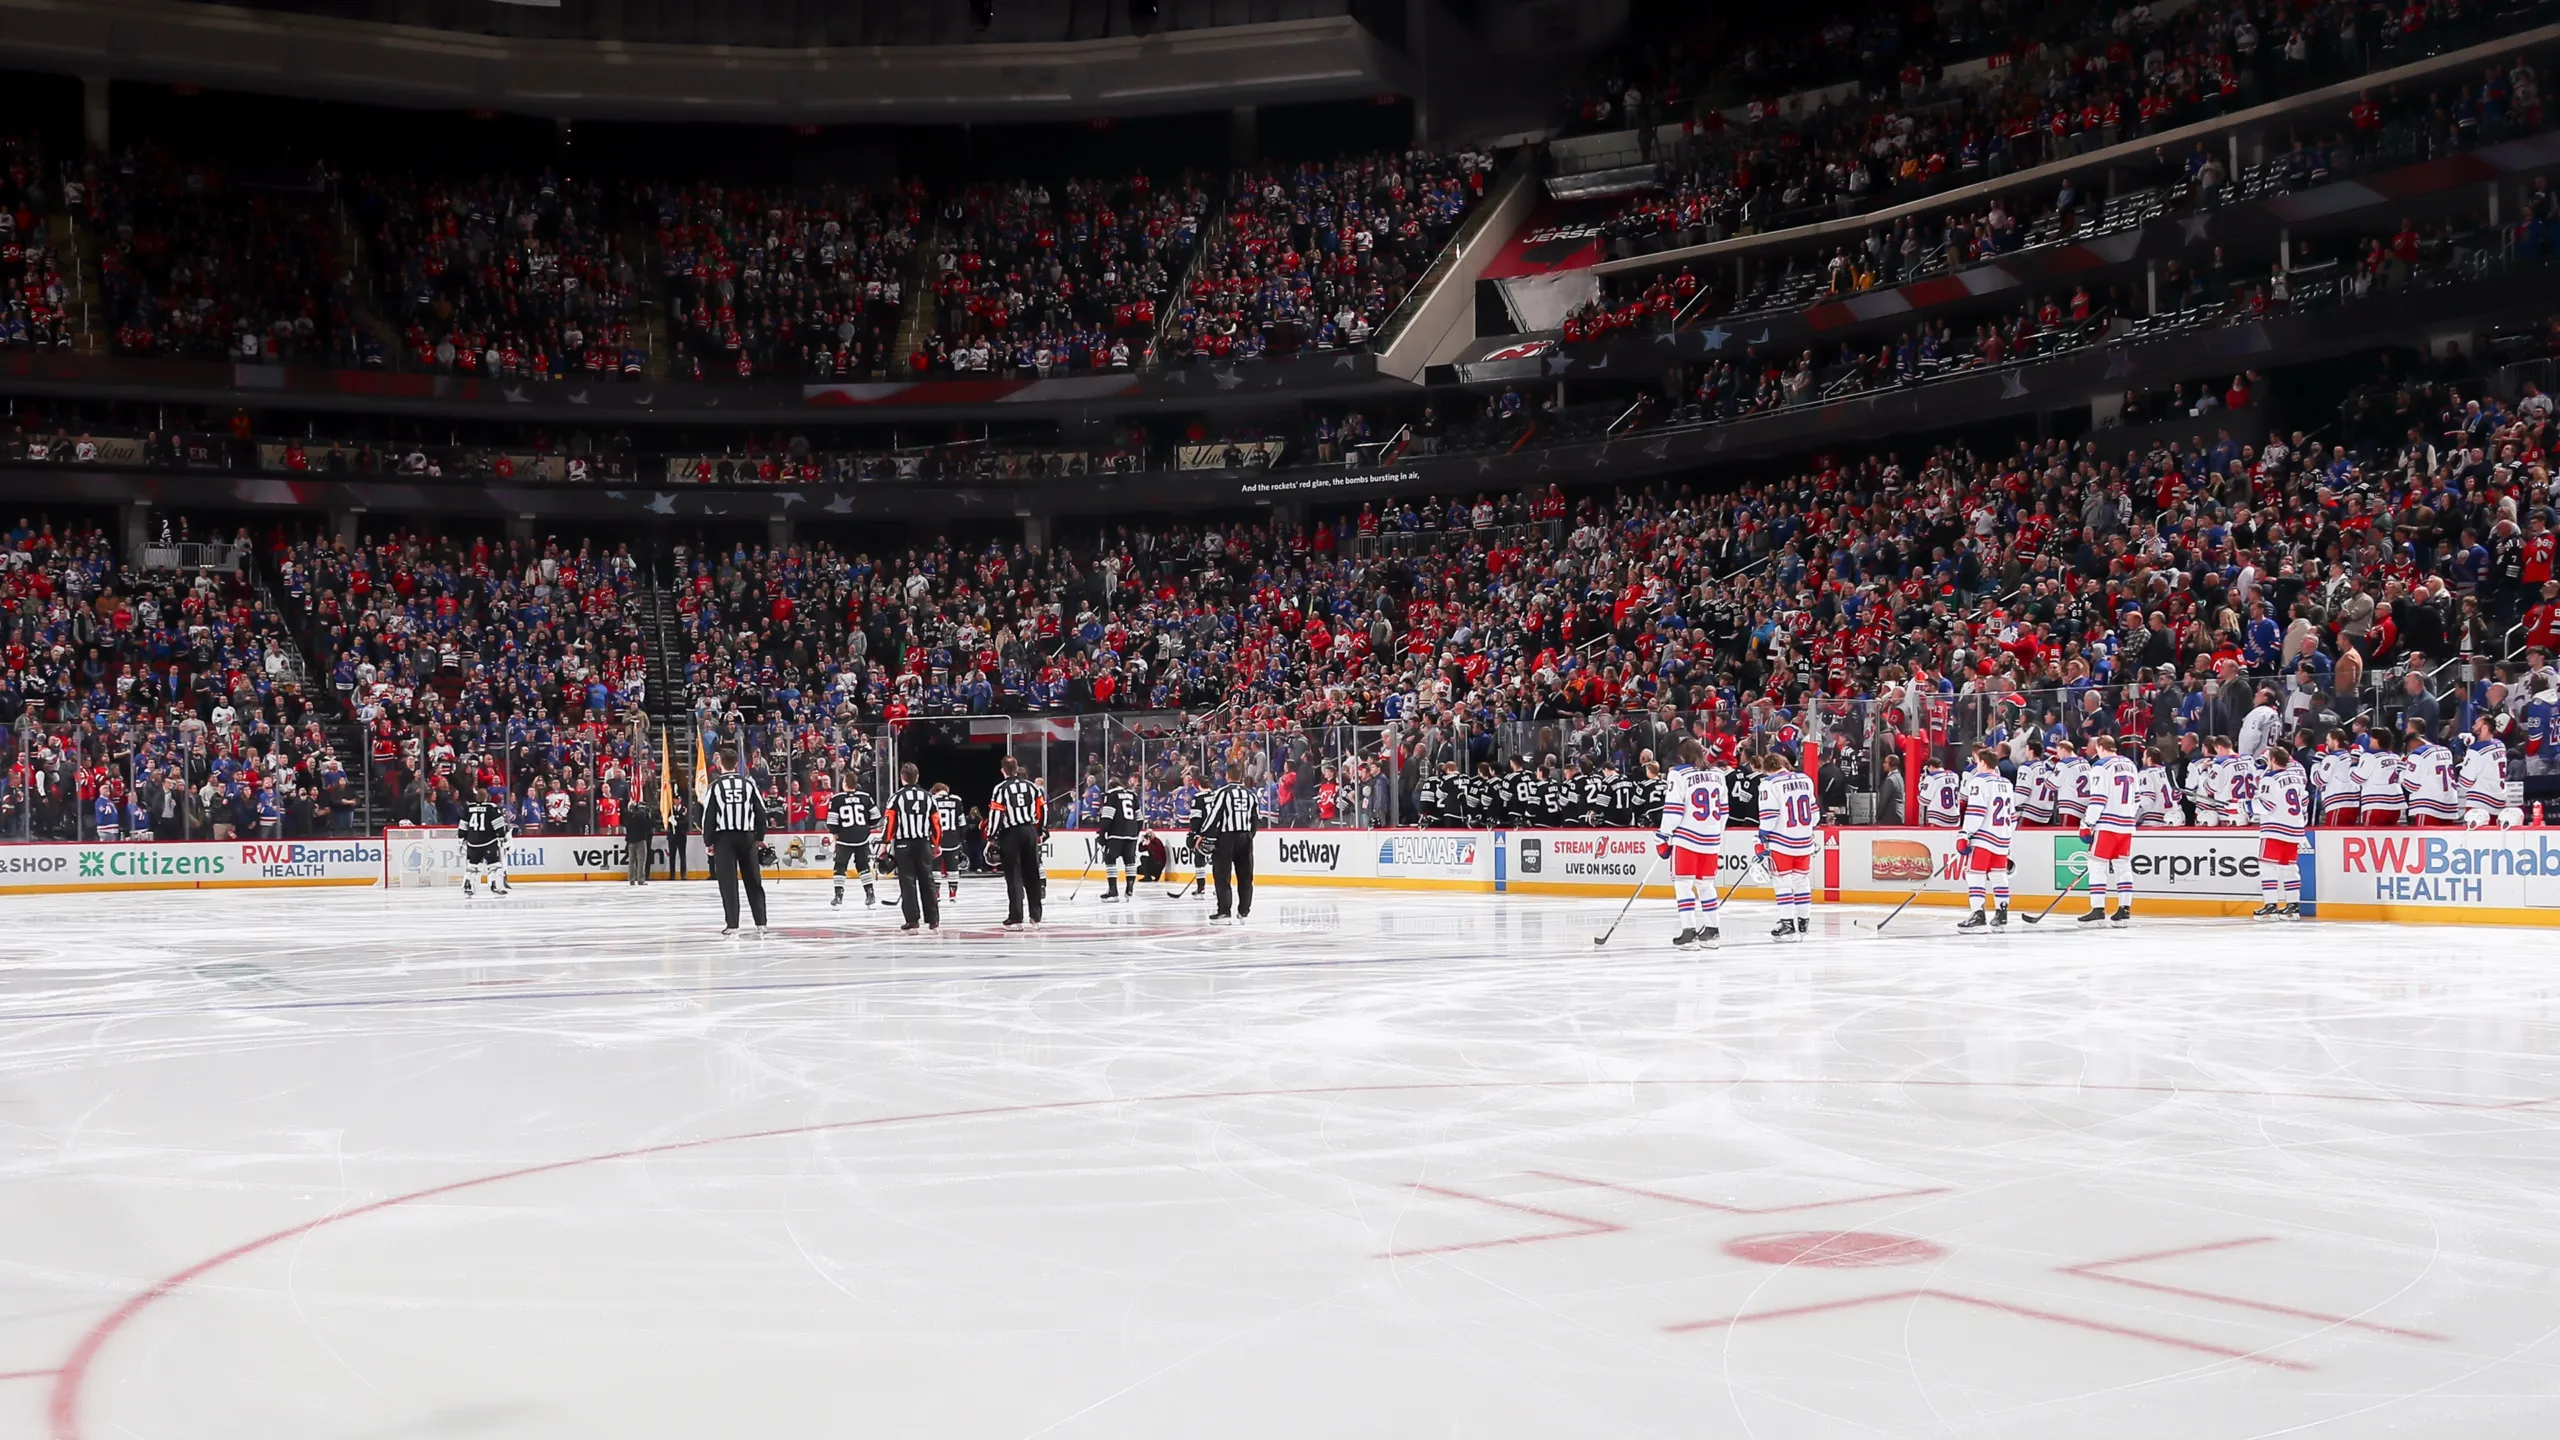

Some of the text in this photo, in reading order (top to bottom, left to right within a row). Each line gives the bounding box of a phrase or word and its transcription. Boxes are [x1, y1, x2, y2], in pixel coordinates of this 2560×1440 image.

[1531, 223, 1588, 234] MADE
[1241, 471, 1420, 493] And the rockets' red glare, the bombs bursting in air,
[725, 789, 742, 804] 55
[2231, 773, 2256, 800] 26
[911, 802, 920, 814] 4
[1017, 793, 1025, 806] 6
[1233, 798, 1249, 811] 52
[1615, 789, 1630, 809] 17
[1691, 787, 1722, 822] 93
[838, 803, 866, 828] 96
[1123, 800, 1134, 820] 6
[1785, 794, 1812, 828] 10
[1992, 797, 2012, 827] 23
[468, 813, 485, 831] 41
[441, 847, 545, 868] Prntial
[573, 844, 665, 867] verizn
[1279, 838, 1341, 870] betway
[1394, 837, 1459, 865] HALMAR
[1554, 841, 1646, 854] STREAM GAMES
[110, 851, 225, 876] Citizens
[262, 864, 324, 877] HEALTH
[1565, 863, 1636, 875] LIVE ON MSG GO
[2131, 848, 2260, 884] erprise
[2376, 877, 2482, 902] HEALTH
